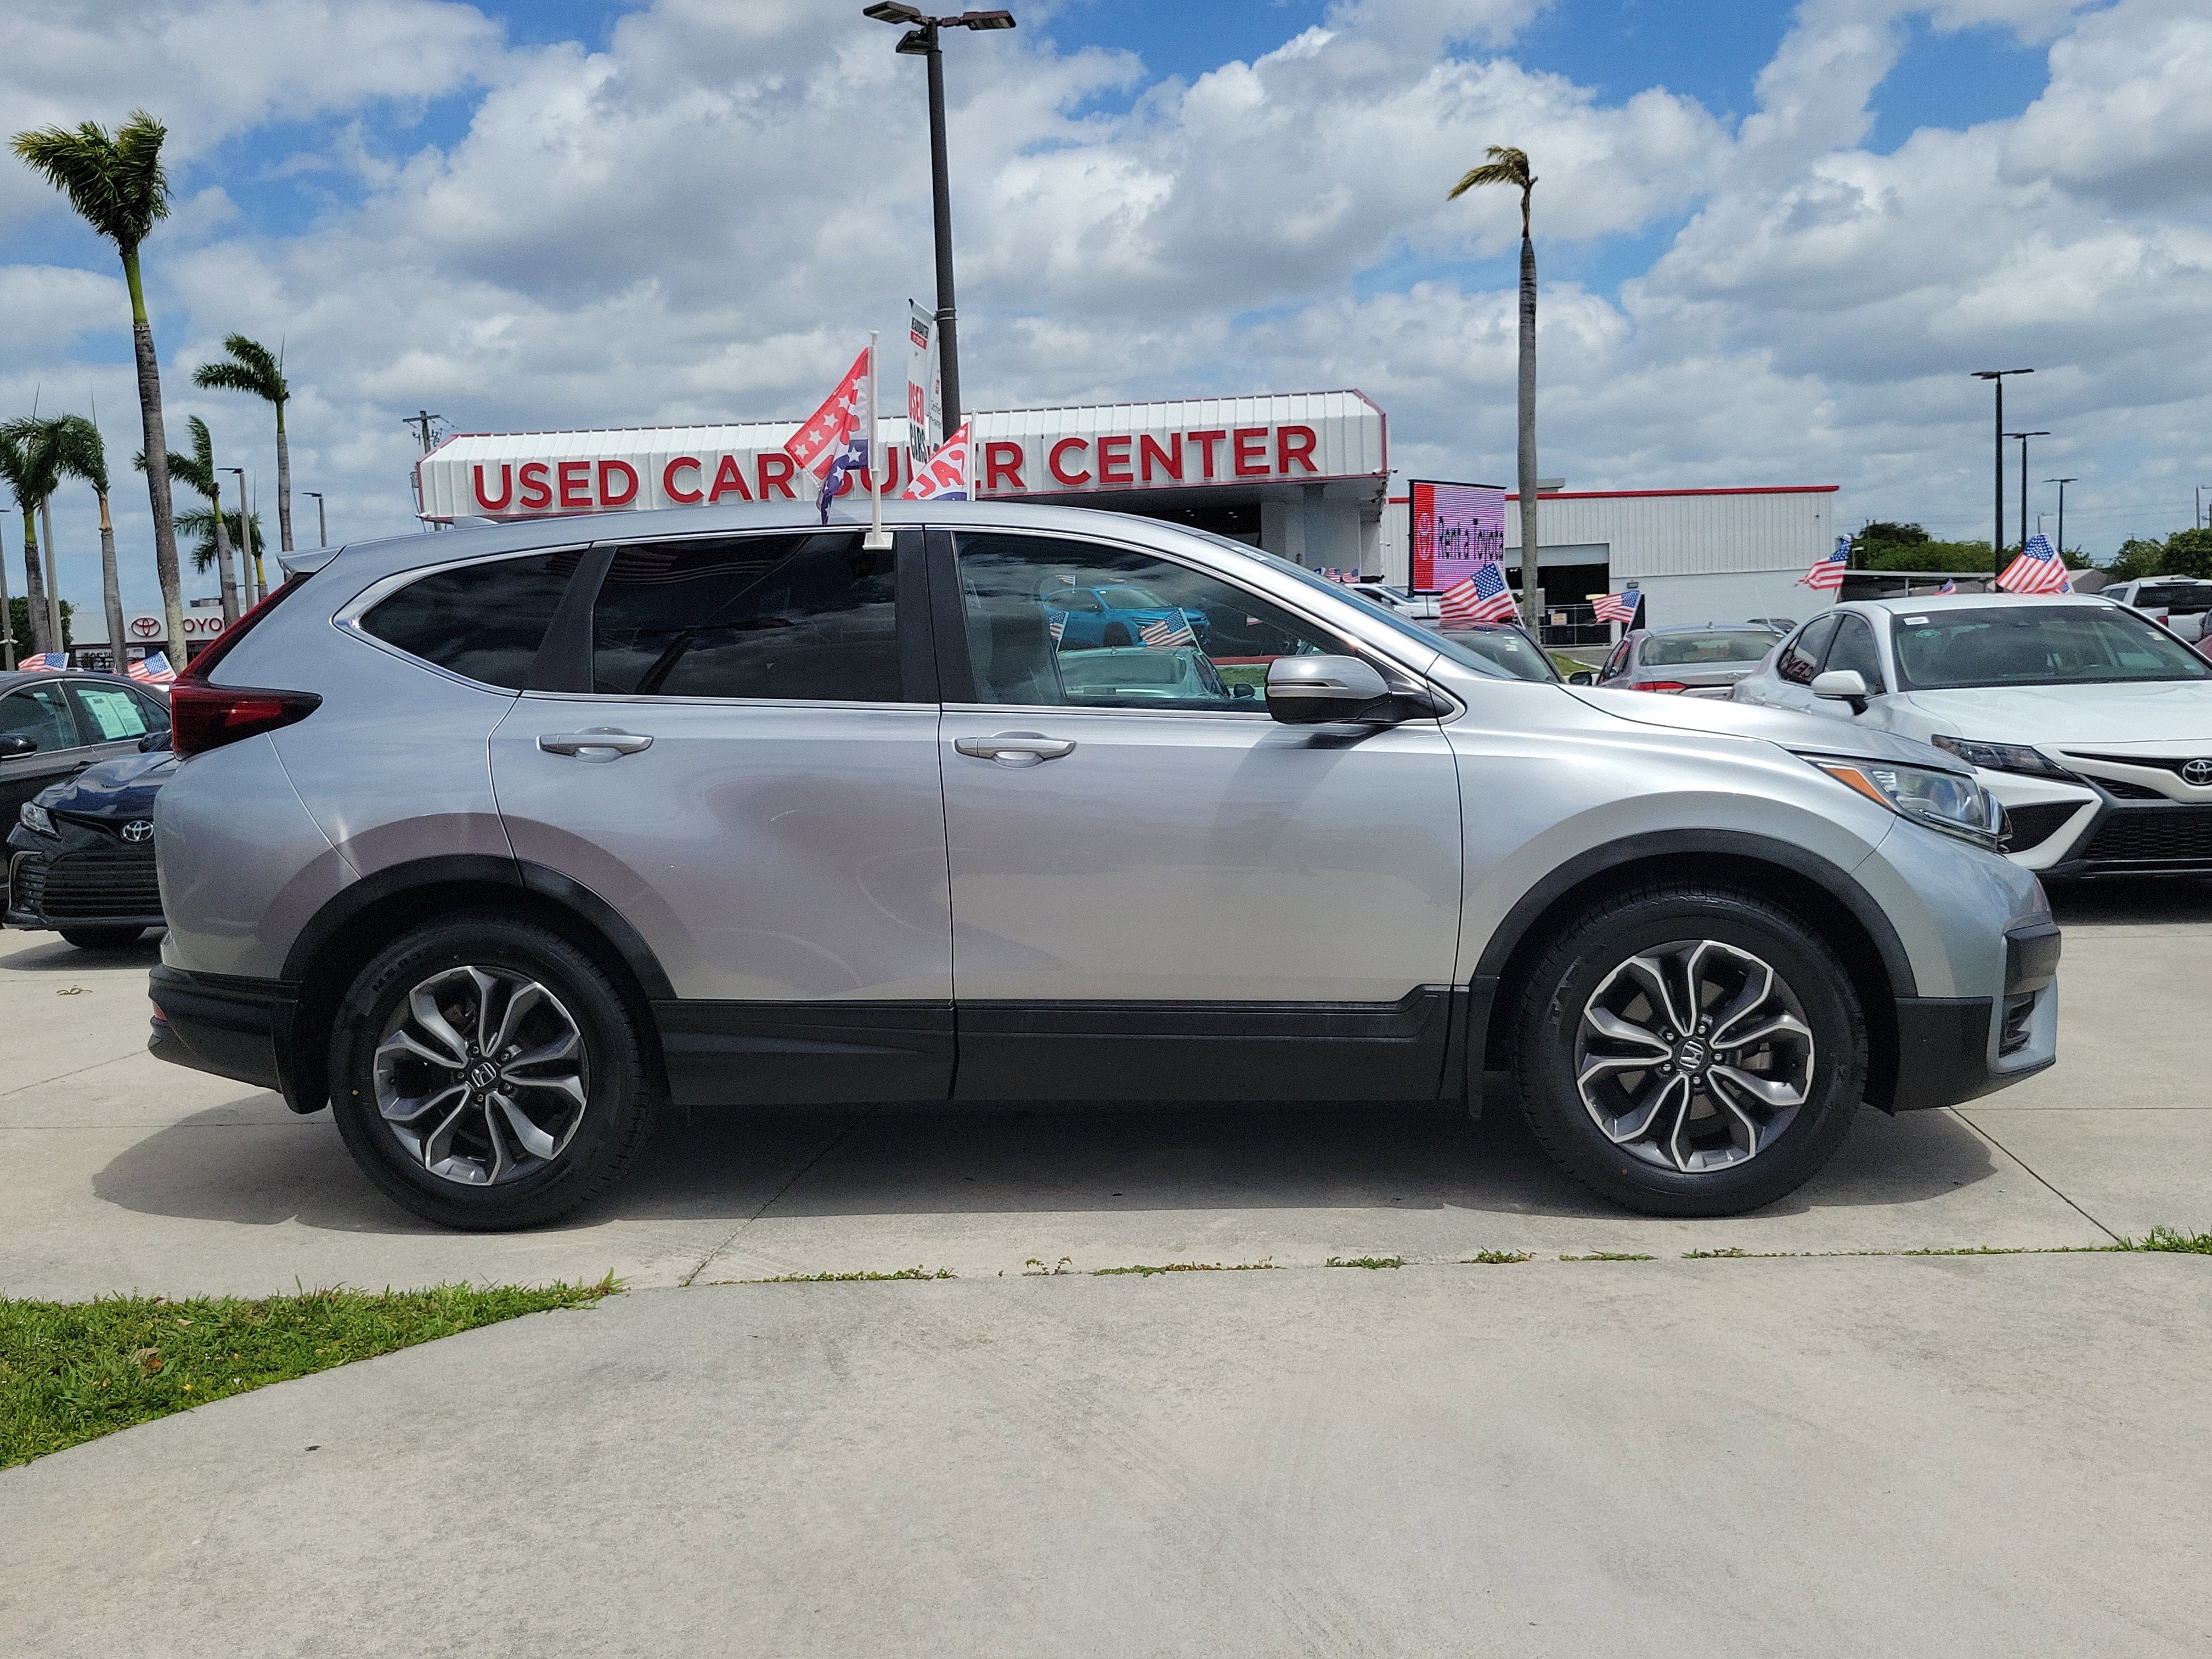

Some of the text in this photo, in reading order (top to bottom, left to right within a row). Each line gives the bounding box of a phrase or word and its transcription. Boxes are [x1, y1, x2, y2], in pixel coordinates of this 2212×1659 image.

[907, 380, 924, 425] USED
[909, 422, 927, 465] CARS
[473, 460, 640, 511] USED
[663, 453, 797, 504] CAR
[1048, 425, 1318, 486] CENTER
[182, 617, 223, 633] OYO
